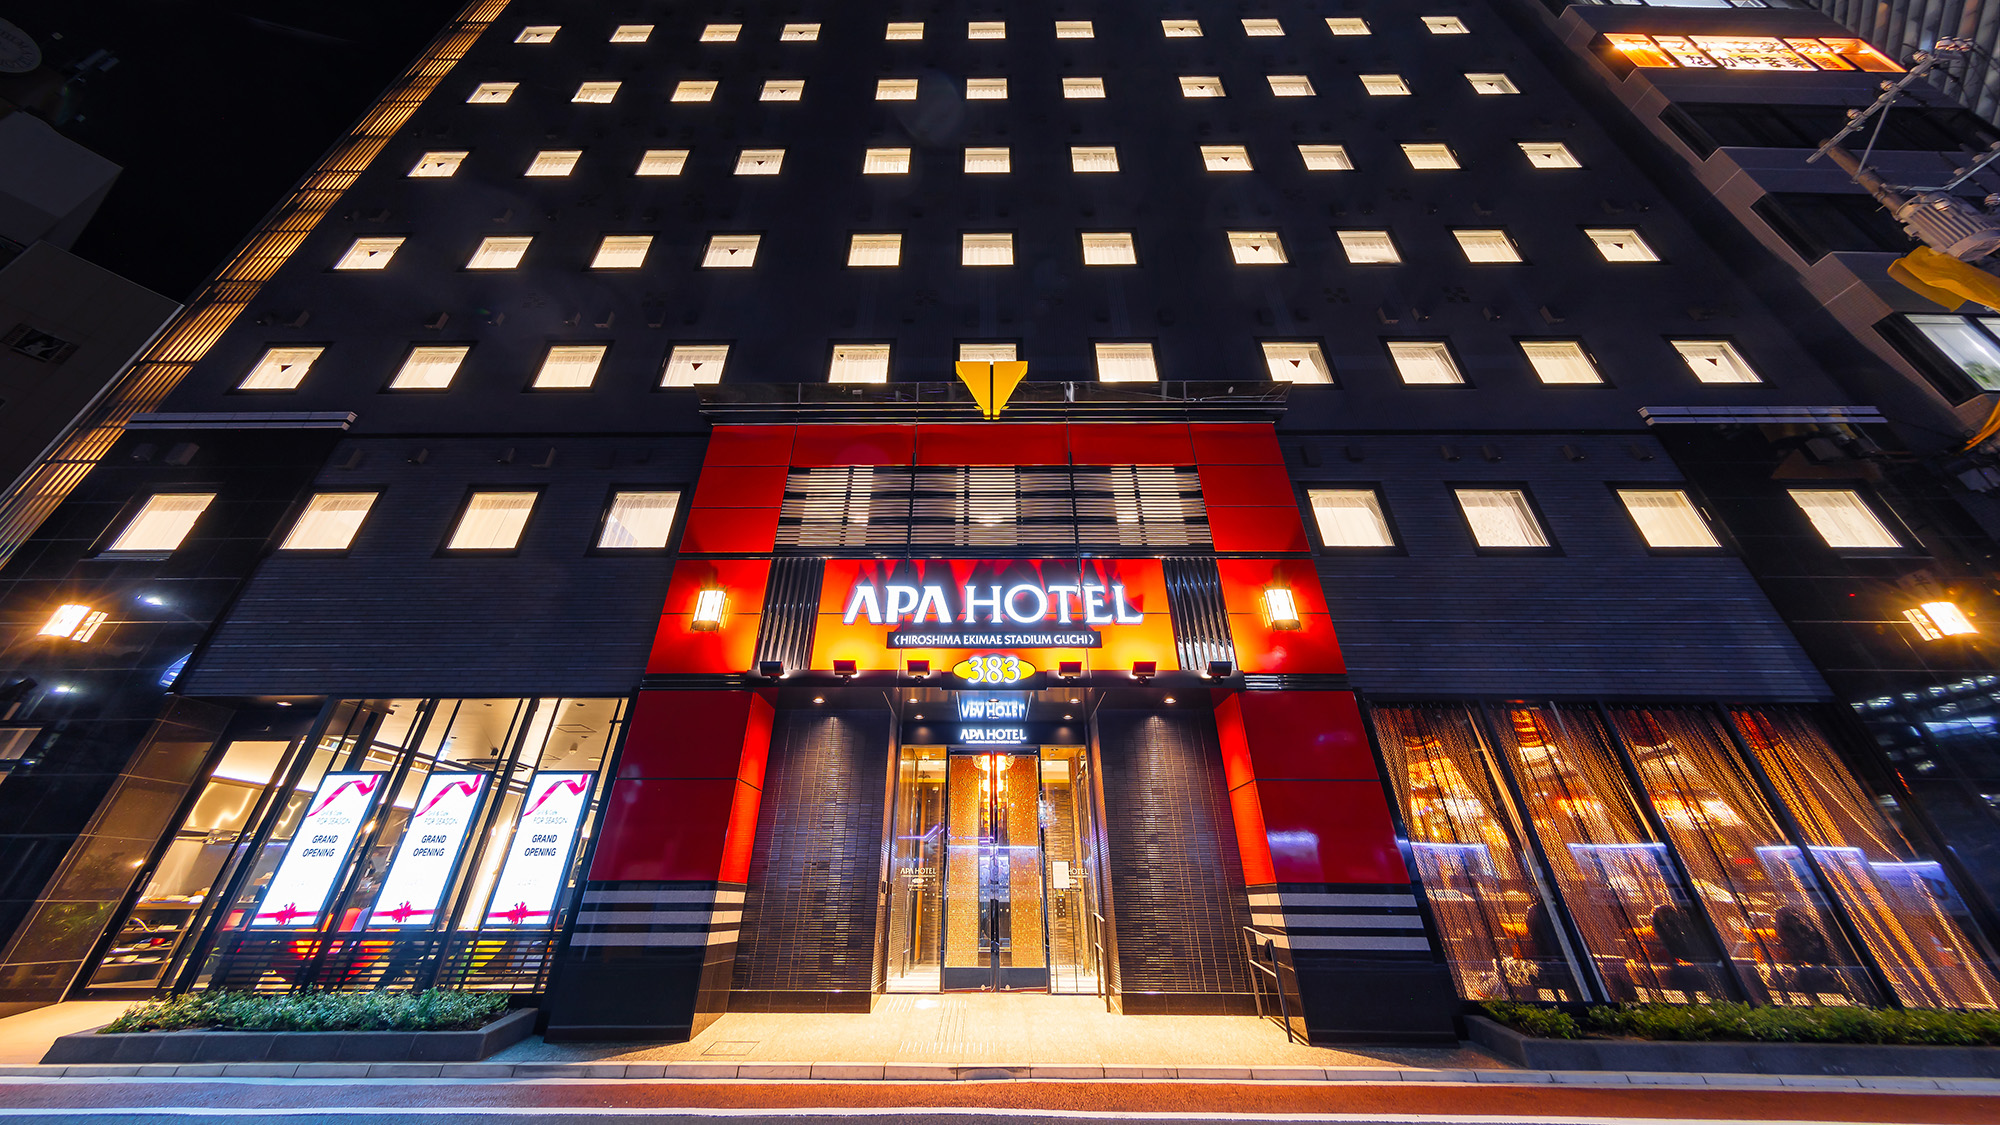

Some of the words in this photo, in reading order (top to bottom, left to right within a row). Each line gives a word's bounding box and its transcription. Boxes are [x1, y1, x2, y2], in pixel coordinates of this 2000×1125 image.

[843, 585, 951, 625] APA
[964, 583, 1144, 625] HOTEL
[963, 634, 1003, 645] EKIMAE
[1004, 634, 1052, 645] STADIUM
[967, 655, 1022, 684] 383
[960, 728, 985, 740] APA
[986, 728, 1027, 740] HOTEL
[312, 834, 338, 844] GRAND
[421, 834, 447, 843] GRAND
[532, 834, 557, 843] GRAND
[302, 848, 335, 857] OPENING
[413, 847, 445, 857] OPENING
[524, 847, 557, 857] OPENING
